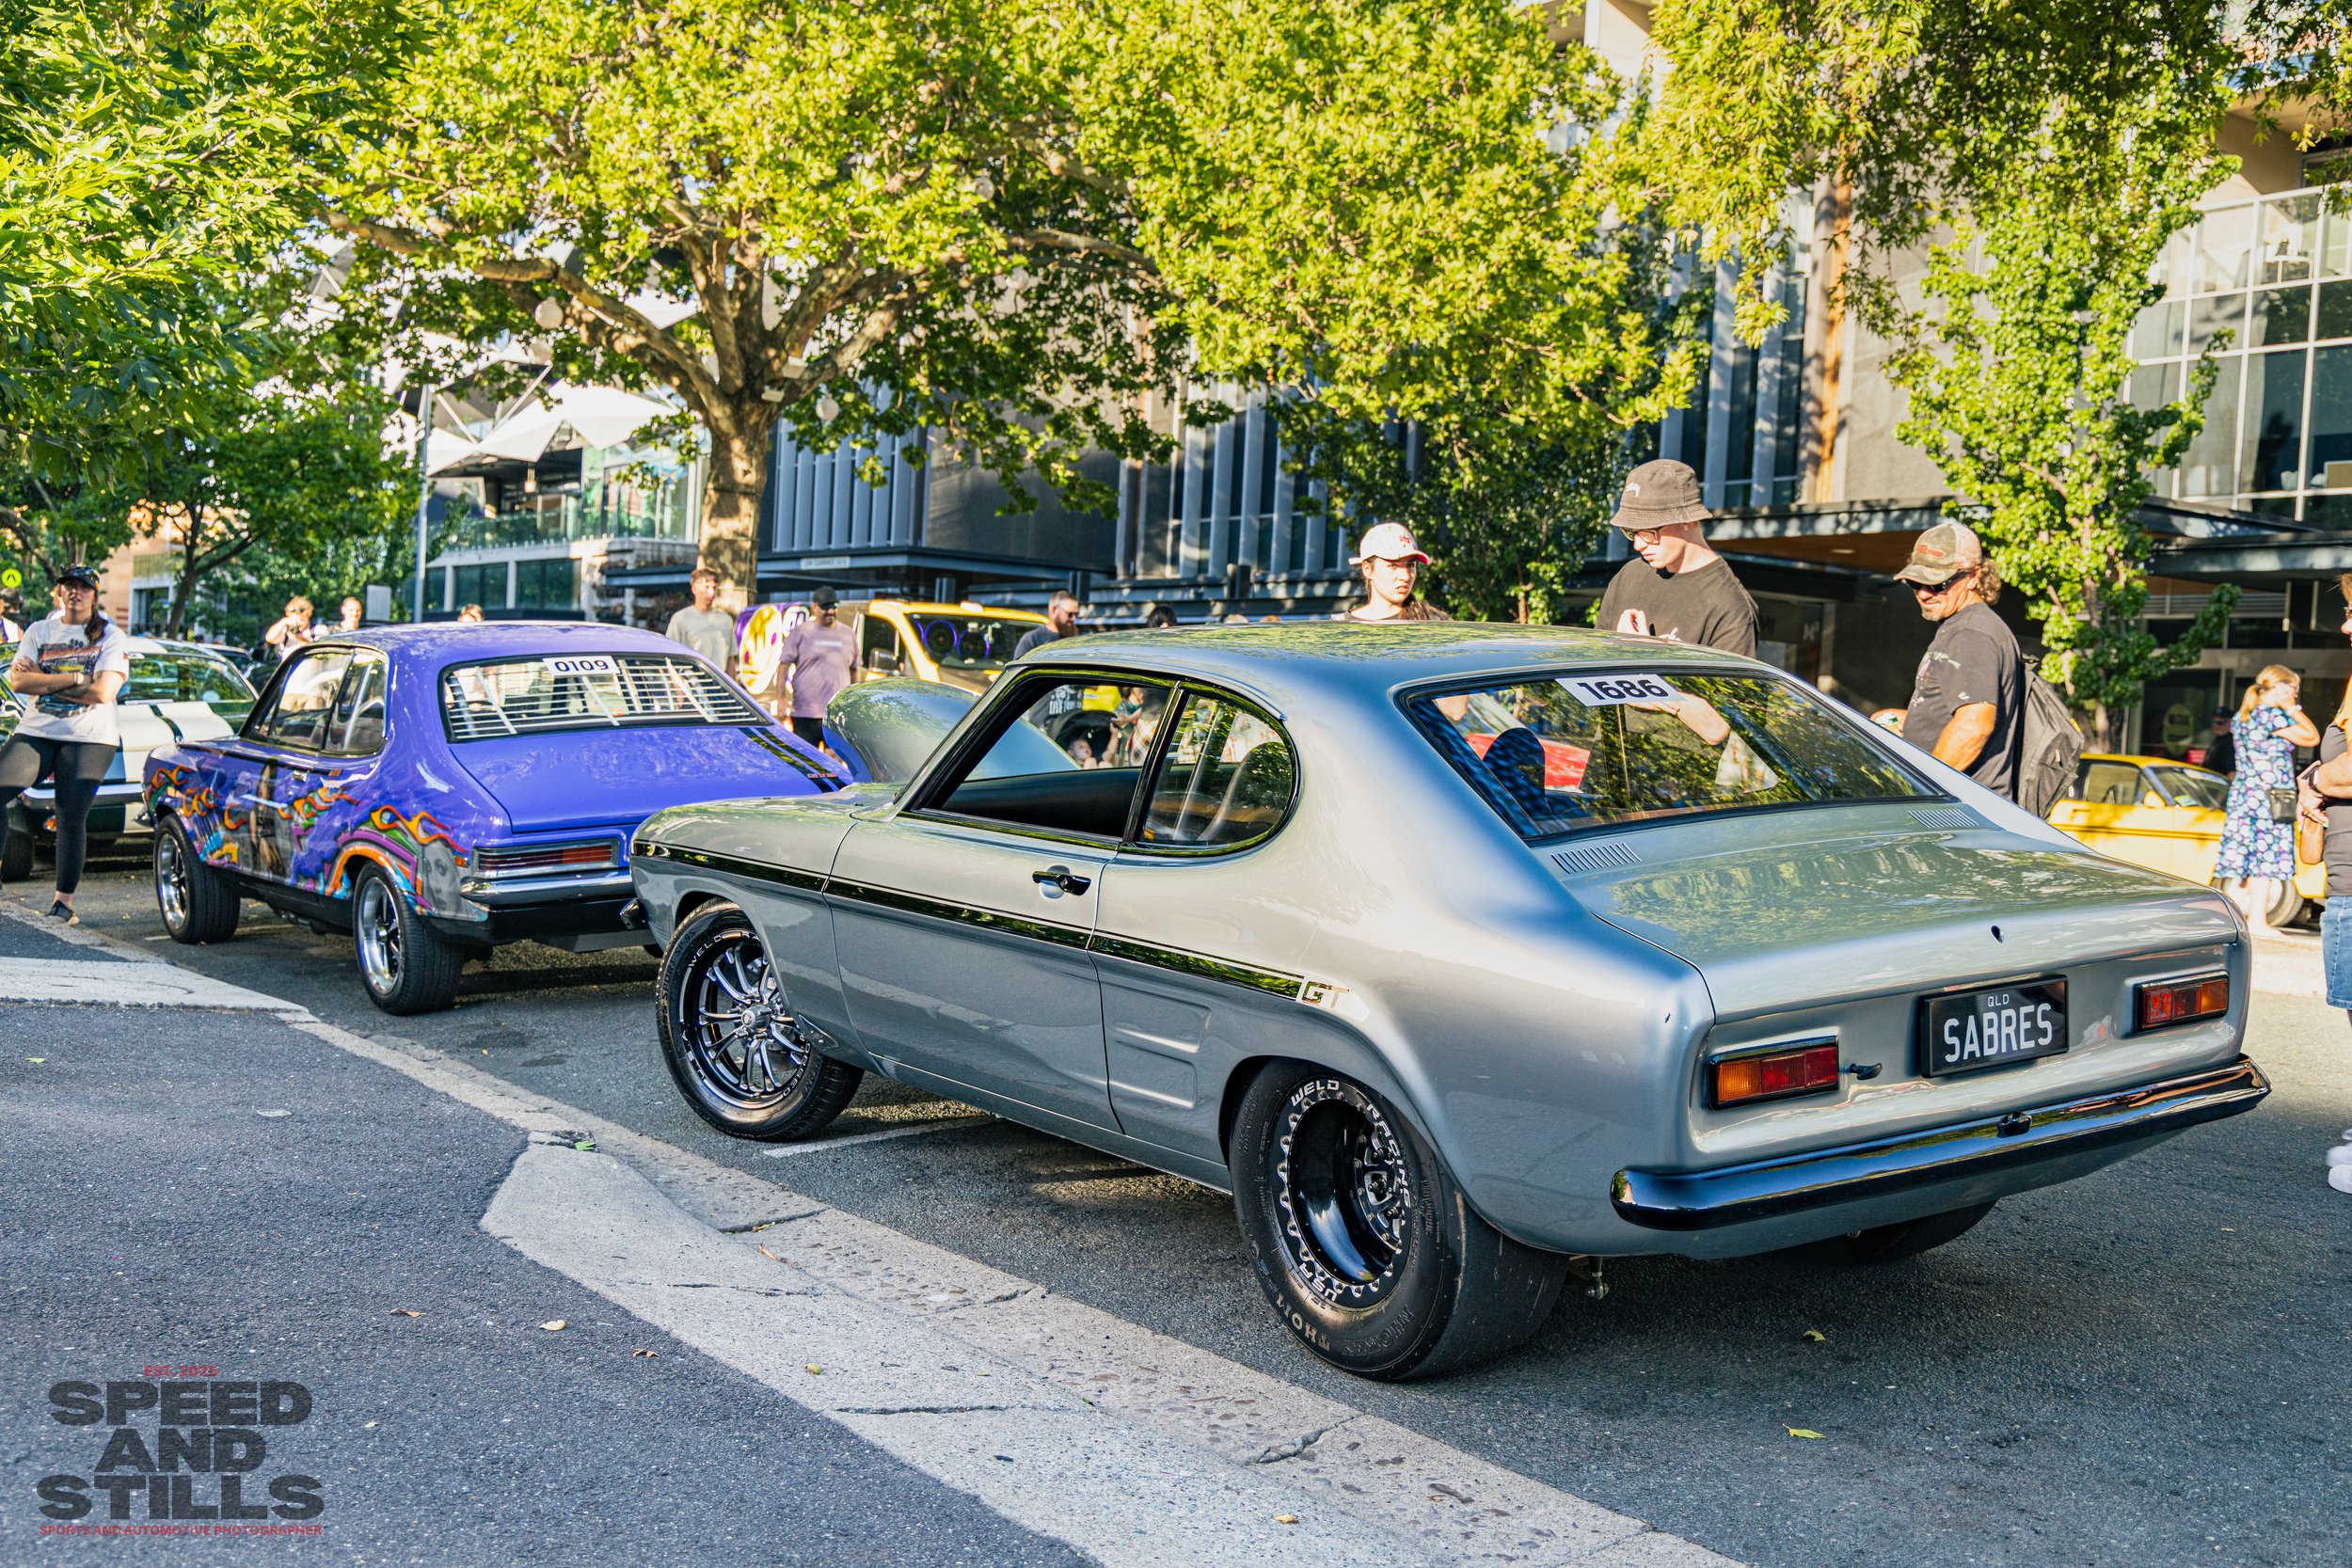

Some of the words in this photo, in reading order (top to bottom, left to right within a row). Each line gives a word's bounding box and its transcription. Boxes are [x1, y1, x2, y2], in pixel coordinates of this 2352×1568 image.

[555, 660, 609, 672] 0109
[1577, 679, 1669, 700] 1686
[688, 933, 723, 968] WELD
[1987, 993, 2010, 1007] QLD
[1944, 1003, 2053, 1063] SABRES
[1291, 1080, 1340, 1107] WELD
[1367, 1103, 1411, 1209] RACING
[1299, 1263, 1338, 1302] USA
